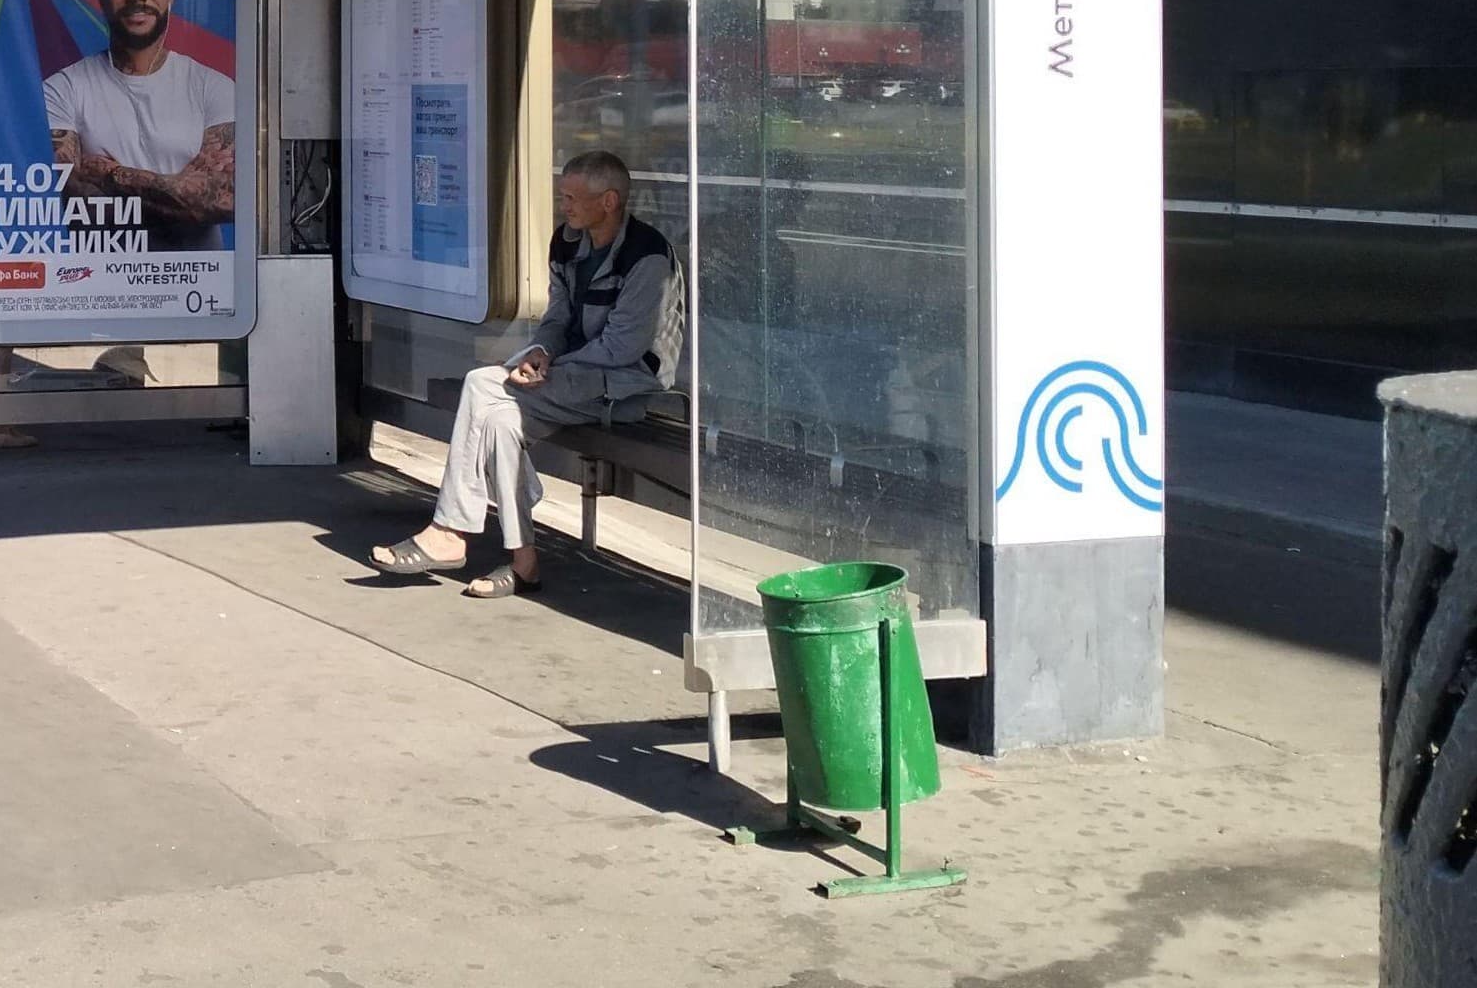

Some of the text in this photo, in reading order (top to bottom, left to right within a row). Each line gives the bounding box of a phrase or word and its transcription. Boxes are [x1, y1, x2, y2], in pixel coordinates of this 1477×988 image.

[106, 262, 219, 274] КУПИТЬ БИЛЕТЫ
[13, 269, 39, 280] Банк
[127, 274, 198, 285] VKFEST.RU
[186, 290, 219, 313] 0+
